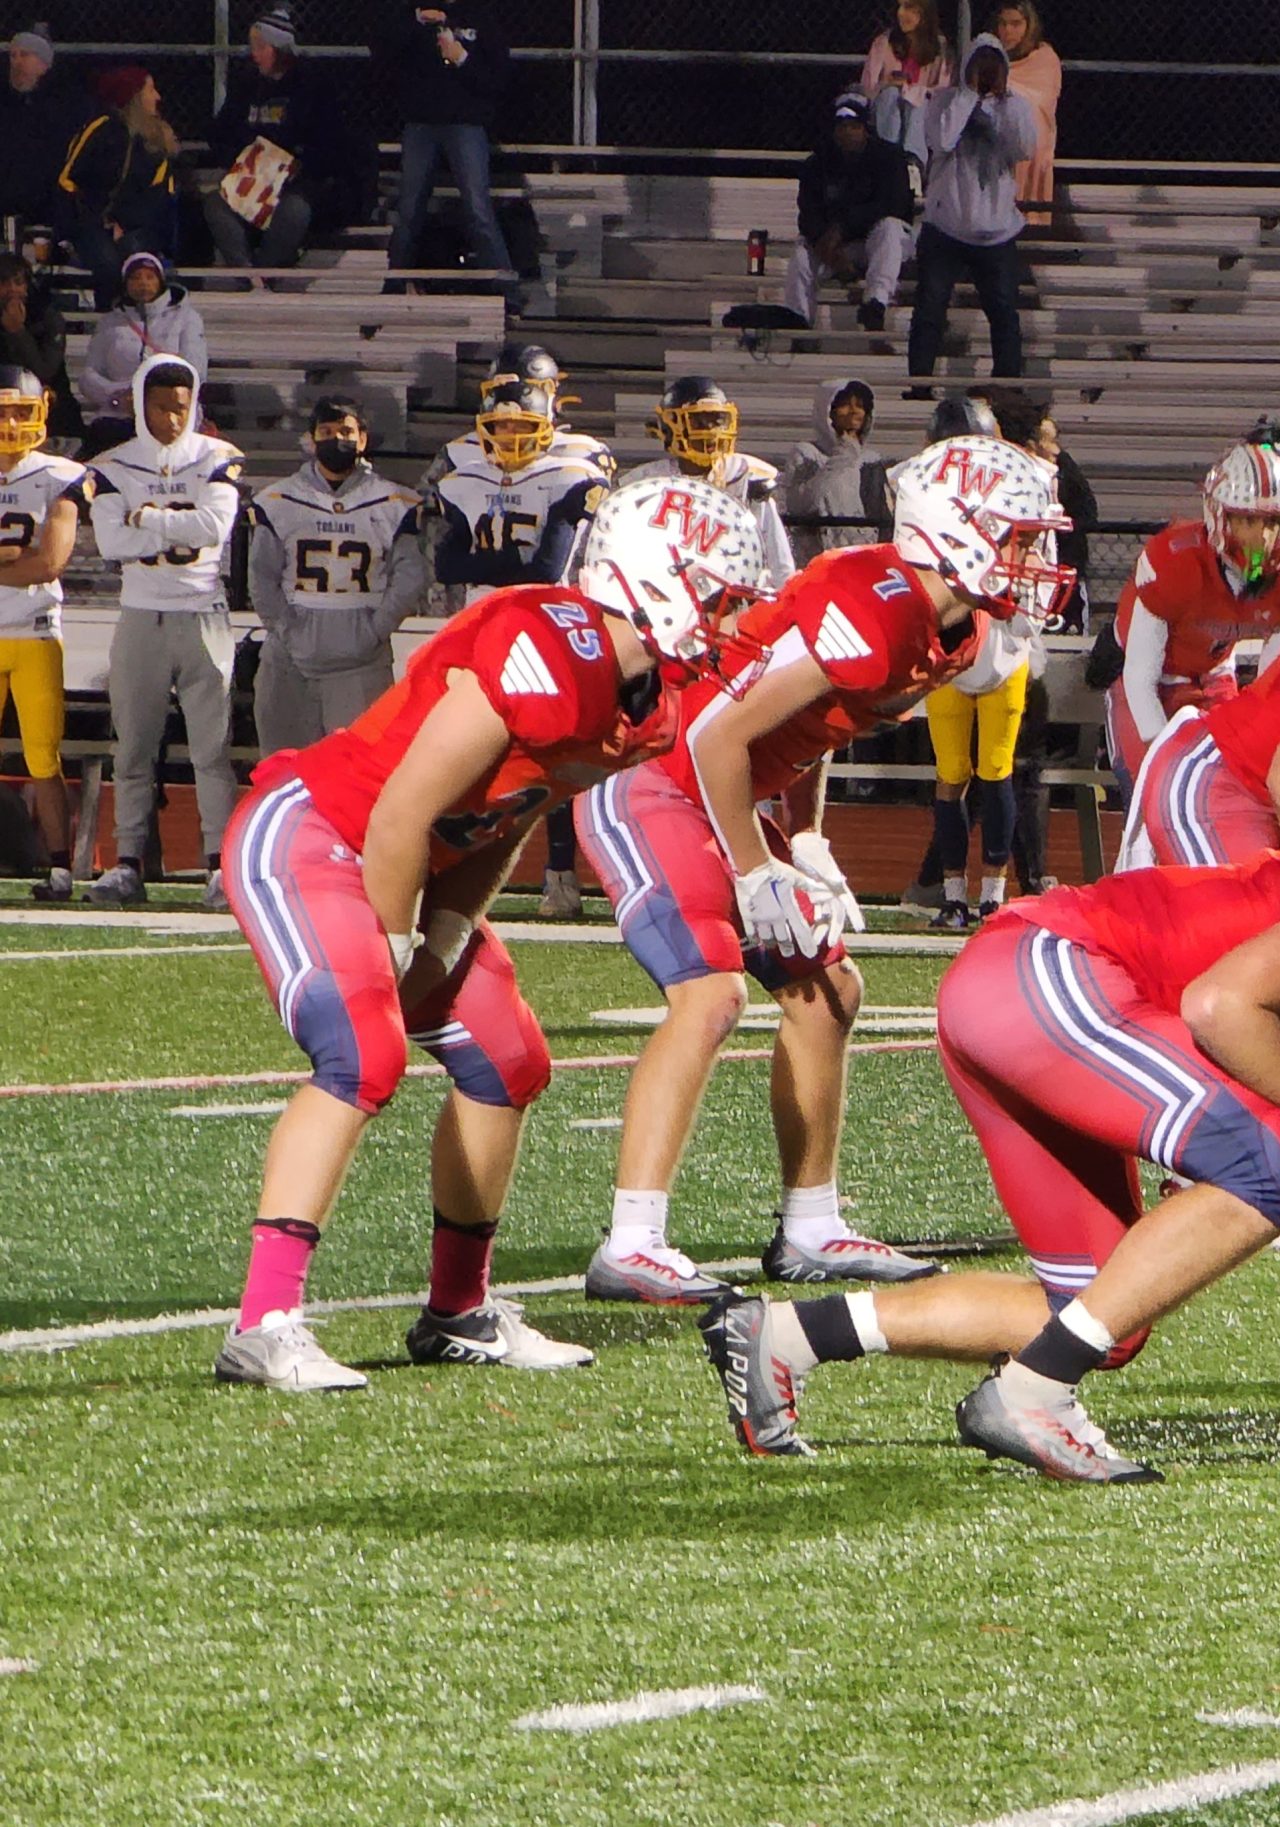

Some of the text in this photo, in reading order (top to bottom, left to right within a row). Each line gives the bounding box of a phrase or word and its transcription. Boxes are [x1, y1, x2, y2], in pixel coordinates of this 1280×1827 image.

[316, 520, 356, 535] TROJANS
[647, 487, 729, 559] RW
[294, 538, 372, 594] 53
[871, 567, 913, 602] 7
[540, 600, 605, 661] 25
